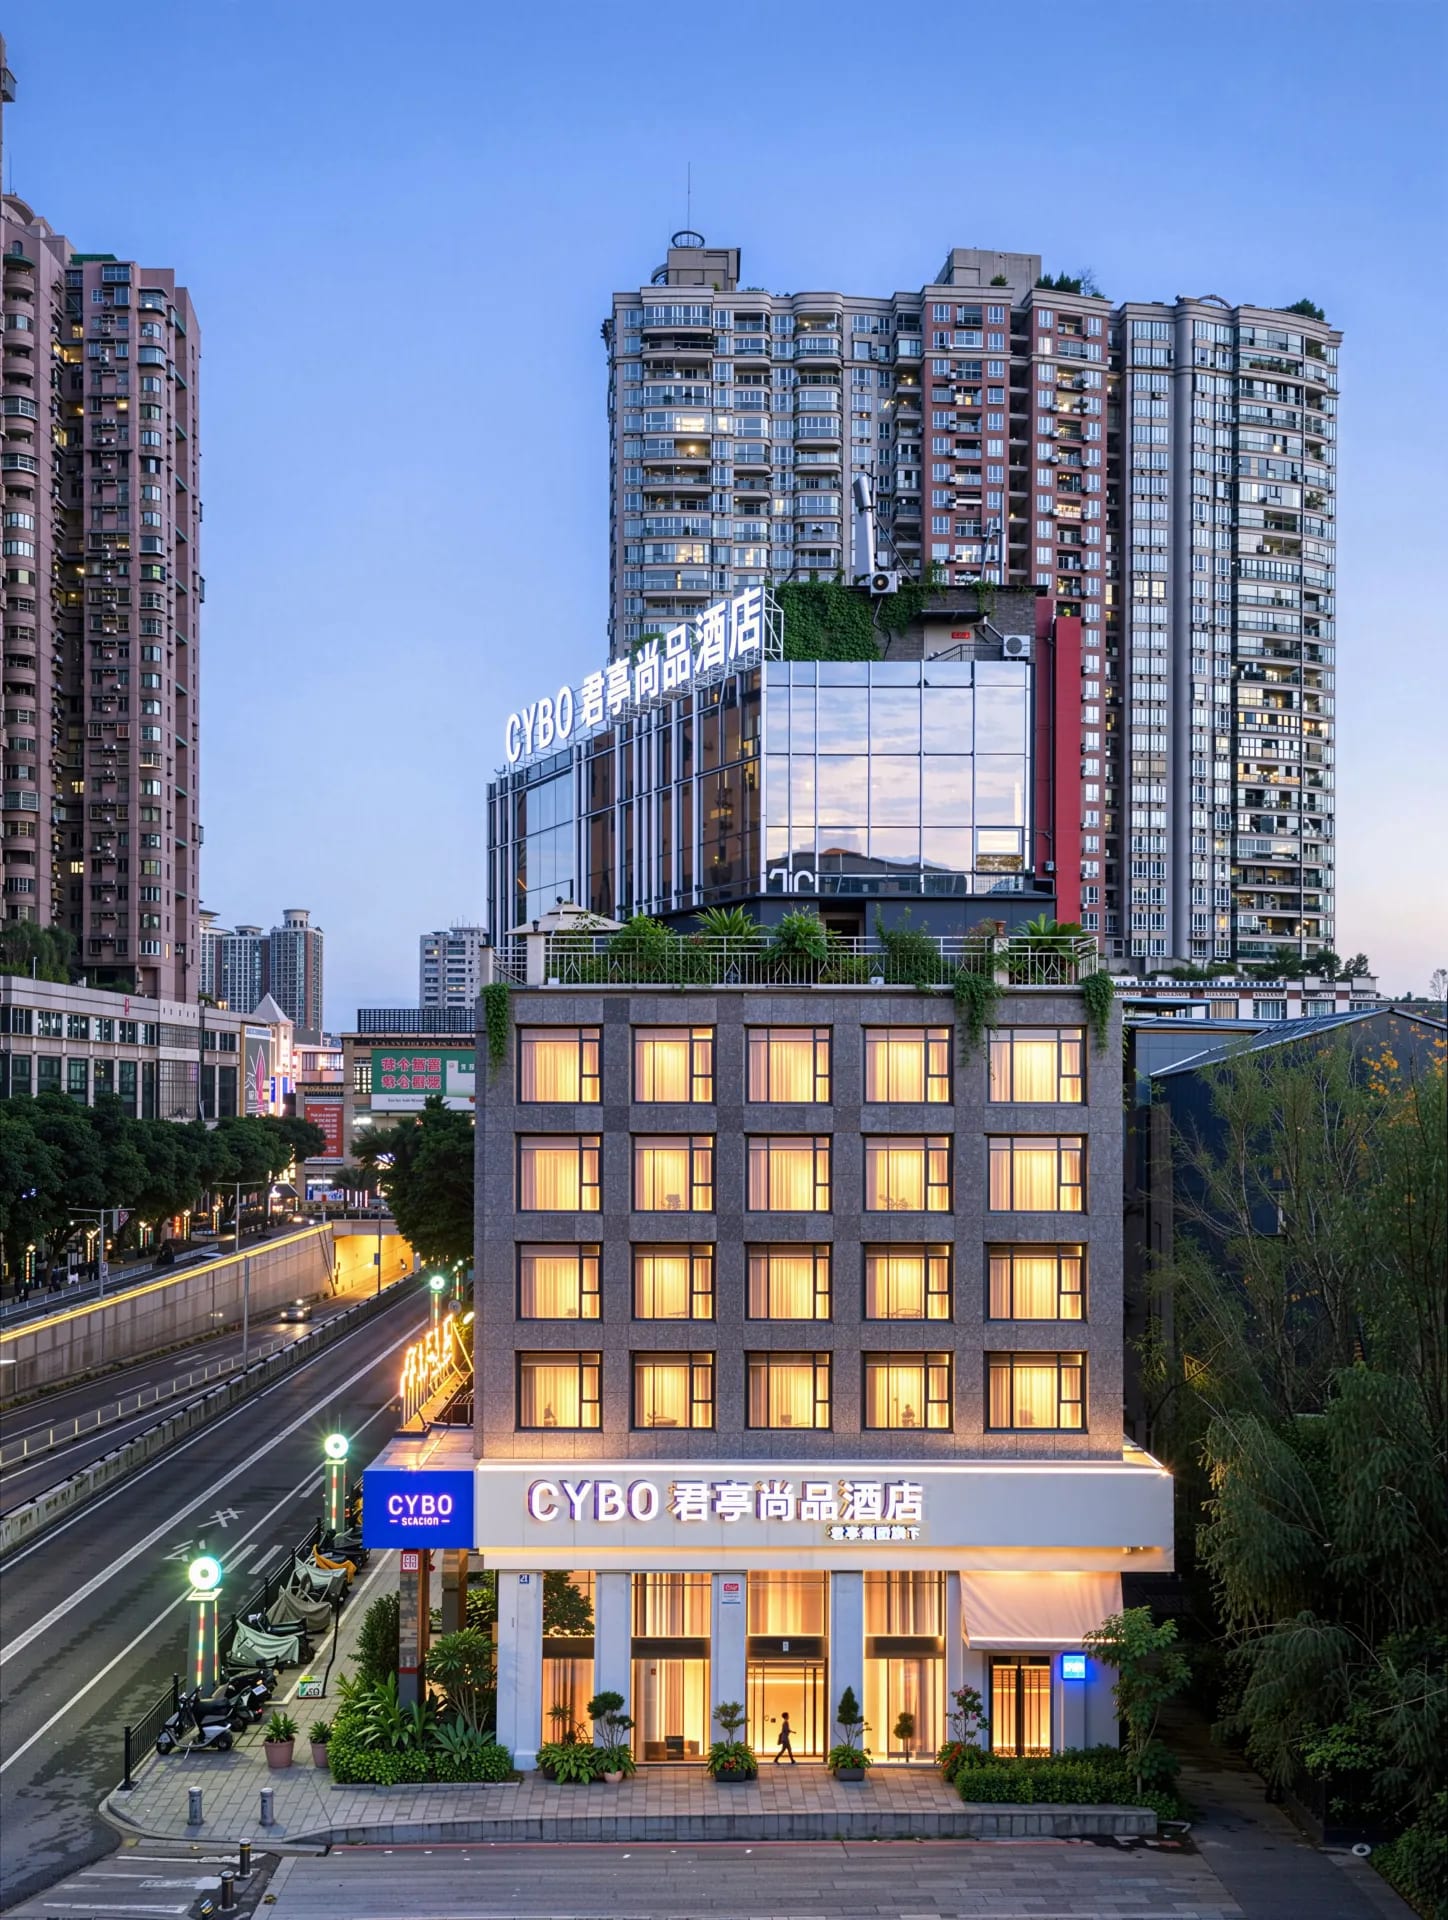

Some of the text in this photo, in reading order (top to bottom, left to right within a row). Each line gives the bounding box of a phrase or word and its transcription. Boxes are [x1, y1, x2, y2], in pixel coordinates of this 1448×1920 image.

[505, 586, 763, 763] CYBO 君亭尚品酒店
[388, 1494, 453, 1515] CYBO
[529, 1480, 923, 1521] CYBO 君亭尚品酒店
